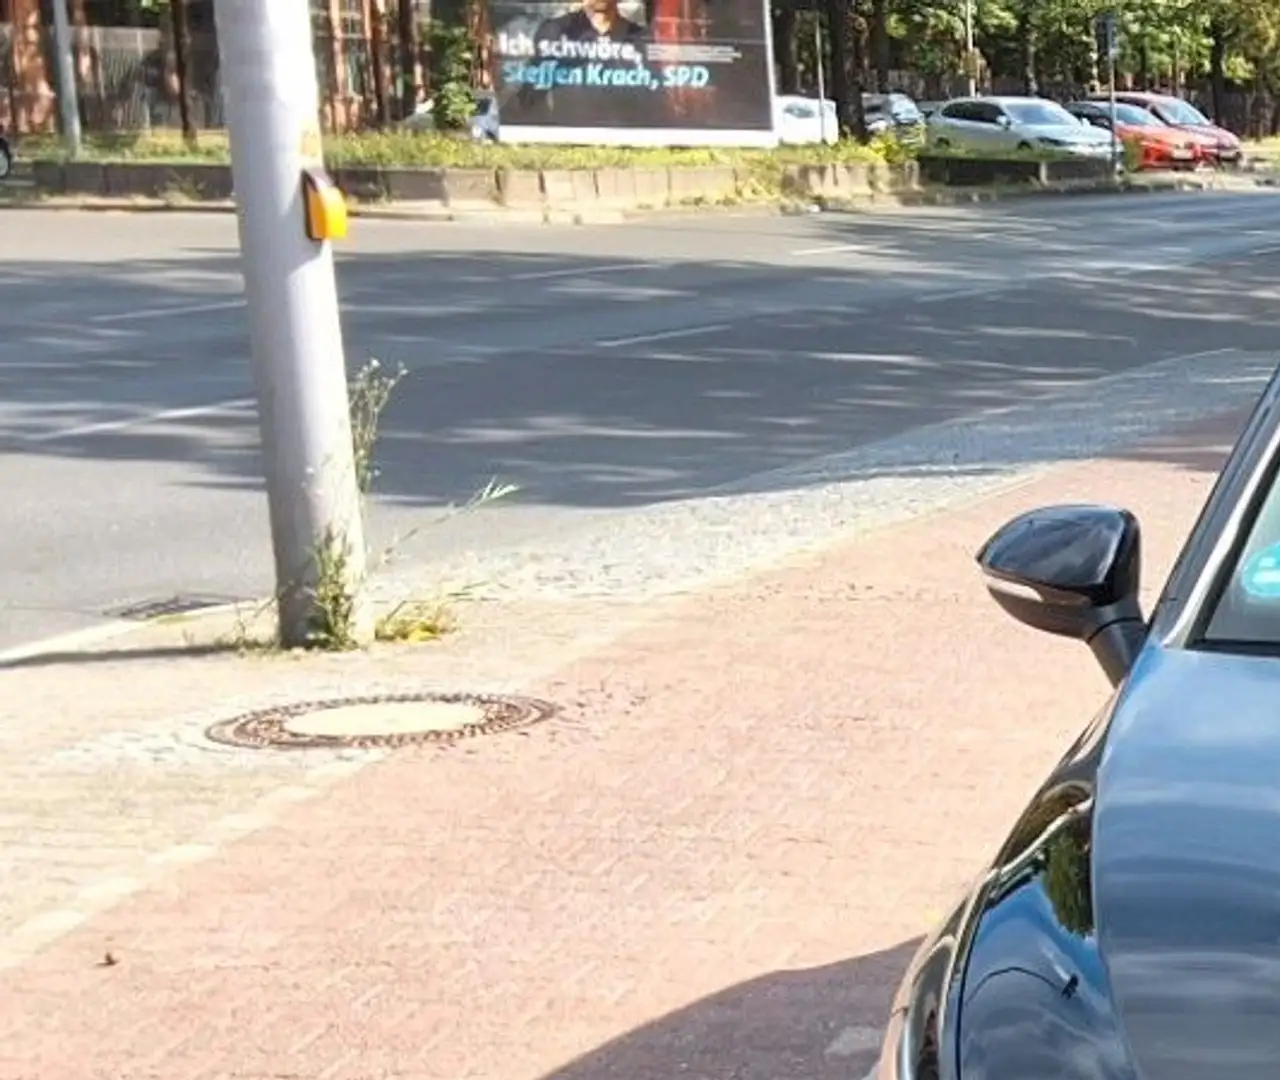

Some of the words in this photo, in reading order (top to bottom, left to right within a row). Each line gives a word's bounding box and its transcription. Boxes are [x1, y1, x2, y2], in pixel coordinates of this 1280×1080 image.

[538, 36, 642, 64] schwöre,
[503, 61, 582, 89] Steffen
[585, 63, 659, 89] Krach,
[662, 65, 709, 86] SPD
